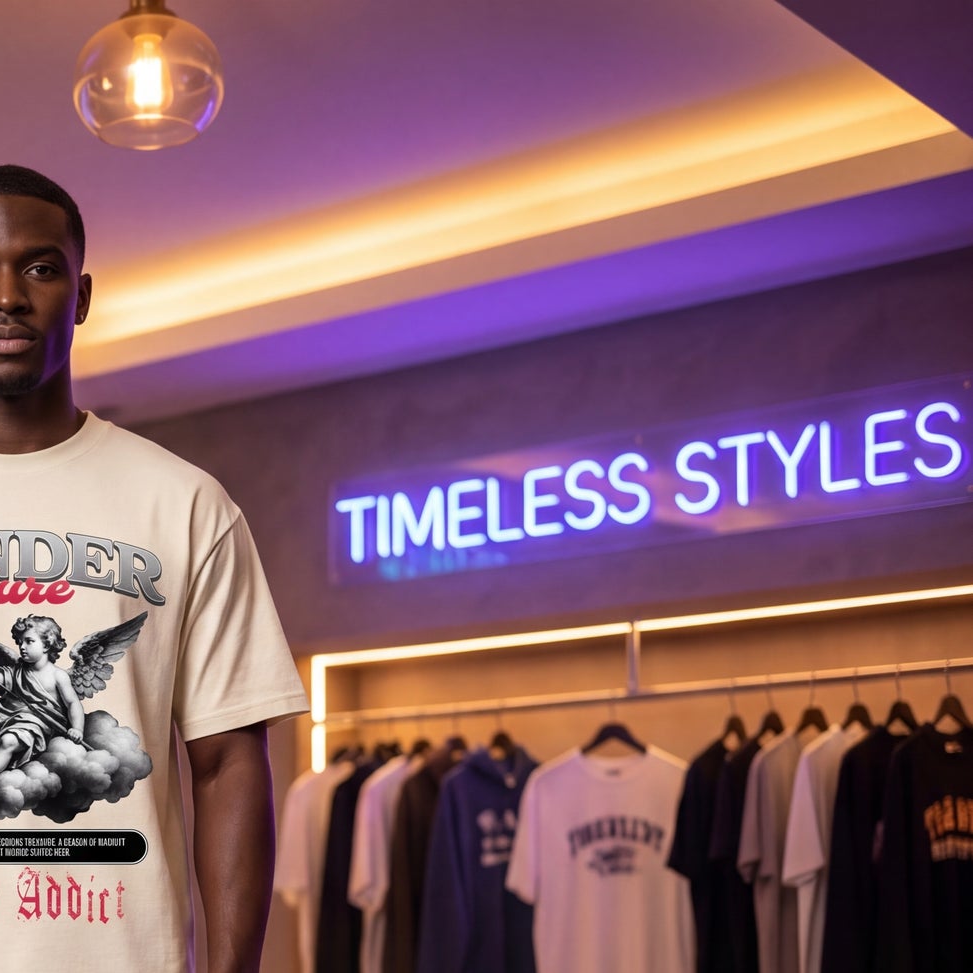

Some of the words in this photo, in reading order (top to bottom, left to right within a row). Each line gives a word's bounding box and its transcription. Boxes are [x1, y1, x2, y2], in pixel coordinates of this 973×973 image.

[335, 451, 652, 563] TIMELESS
[674, 401, 964, 514] STYLES
[89, 837, 97, 847] OF
[17, 866, 125, 924] Addict
